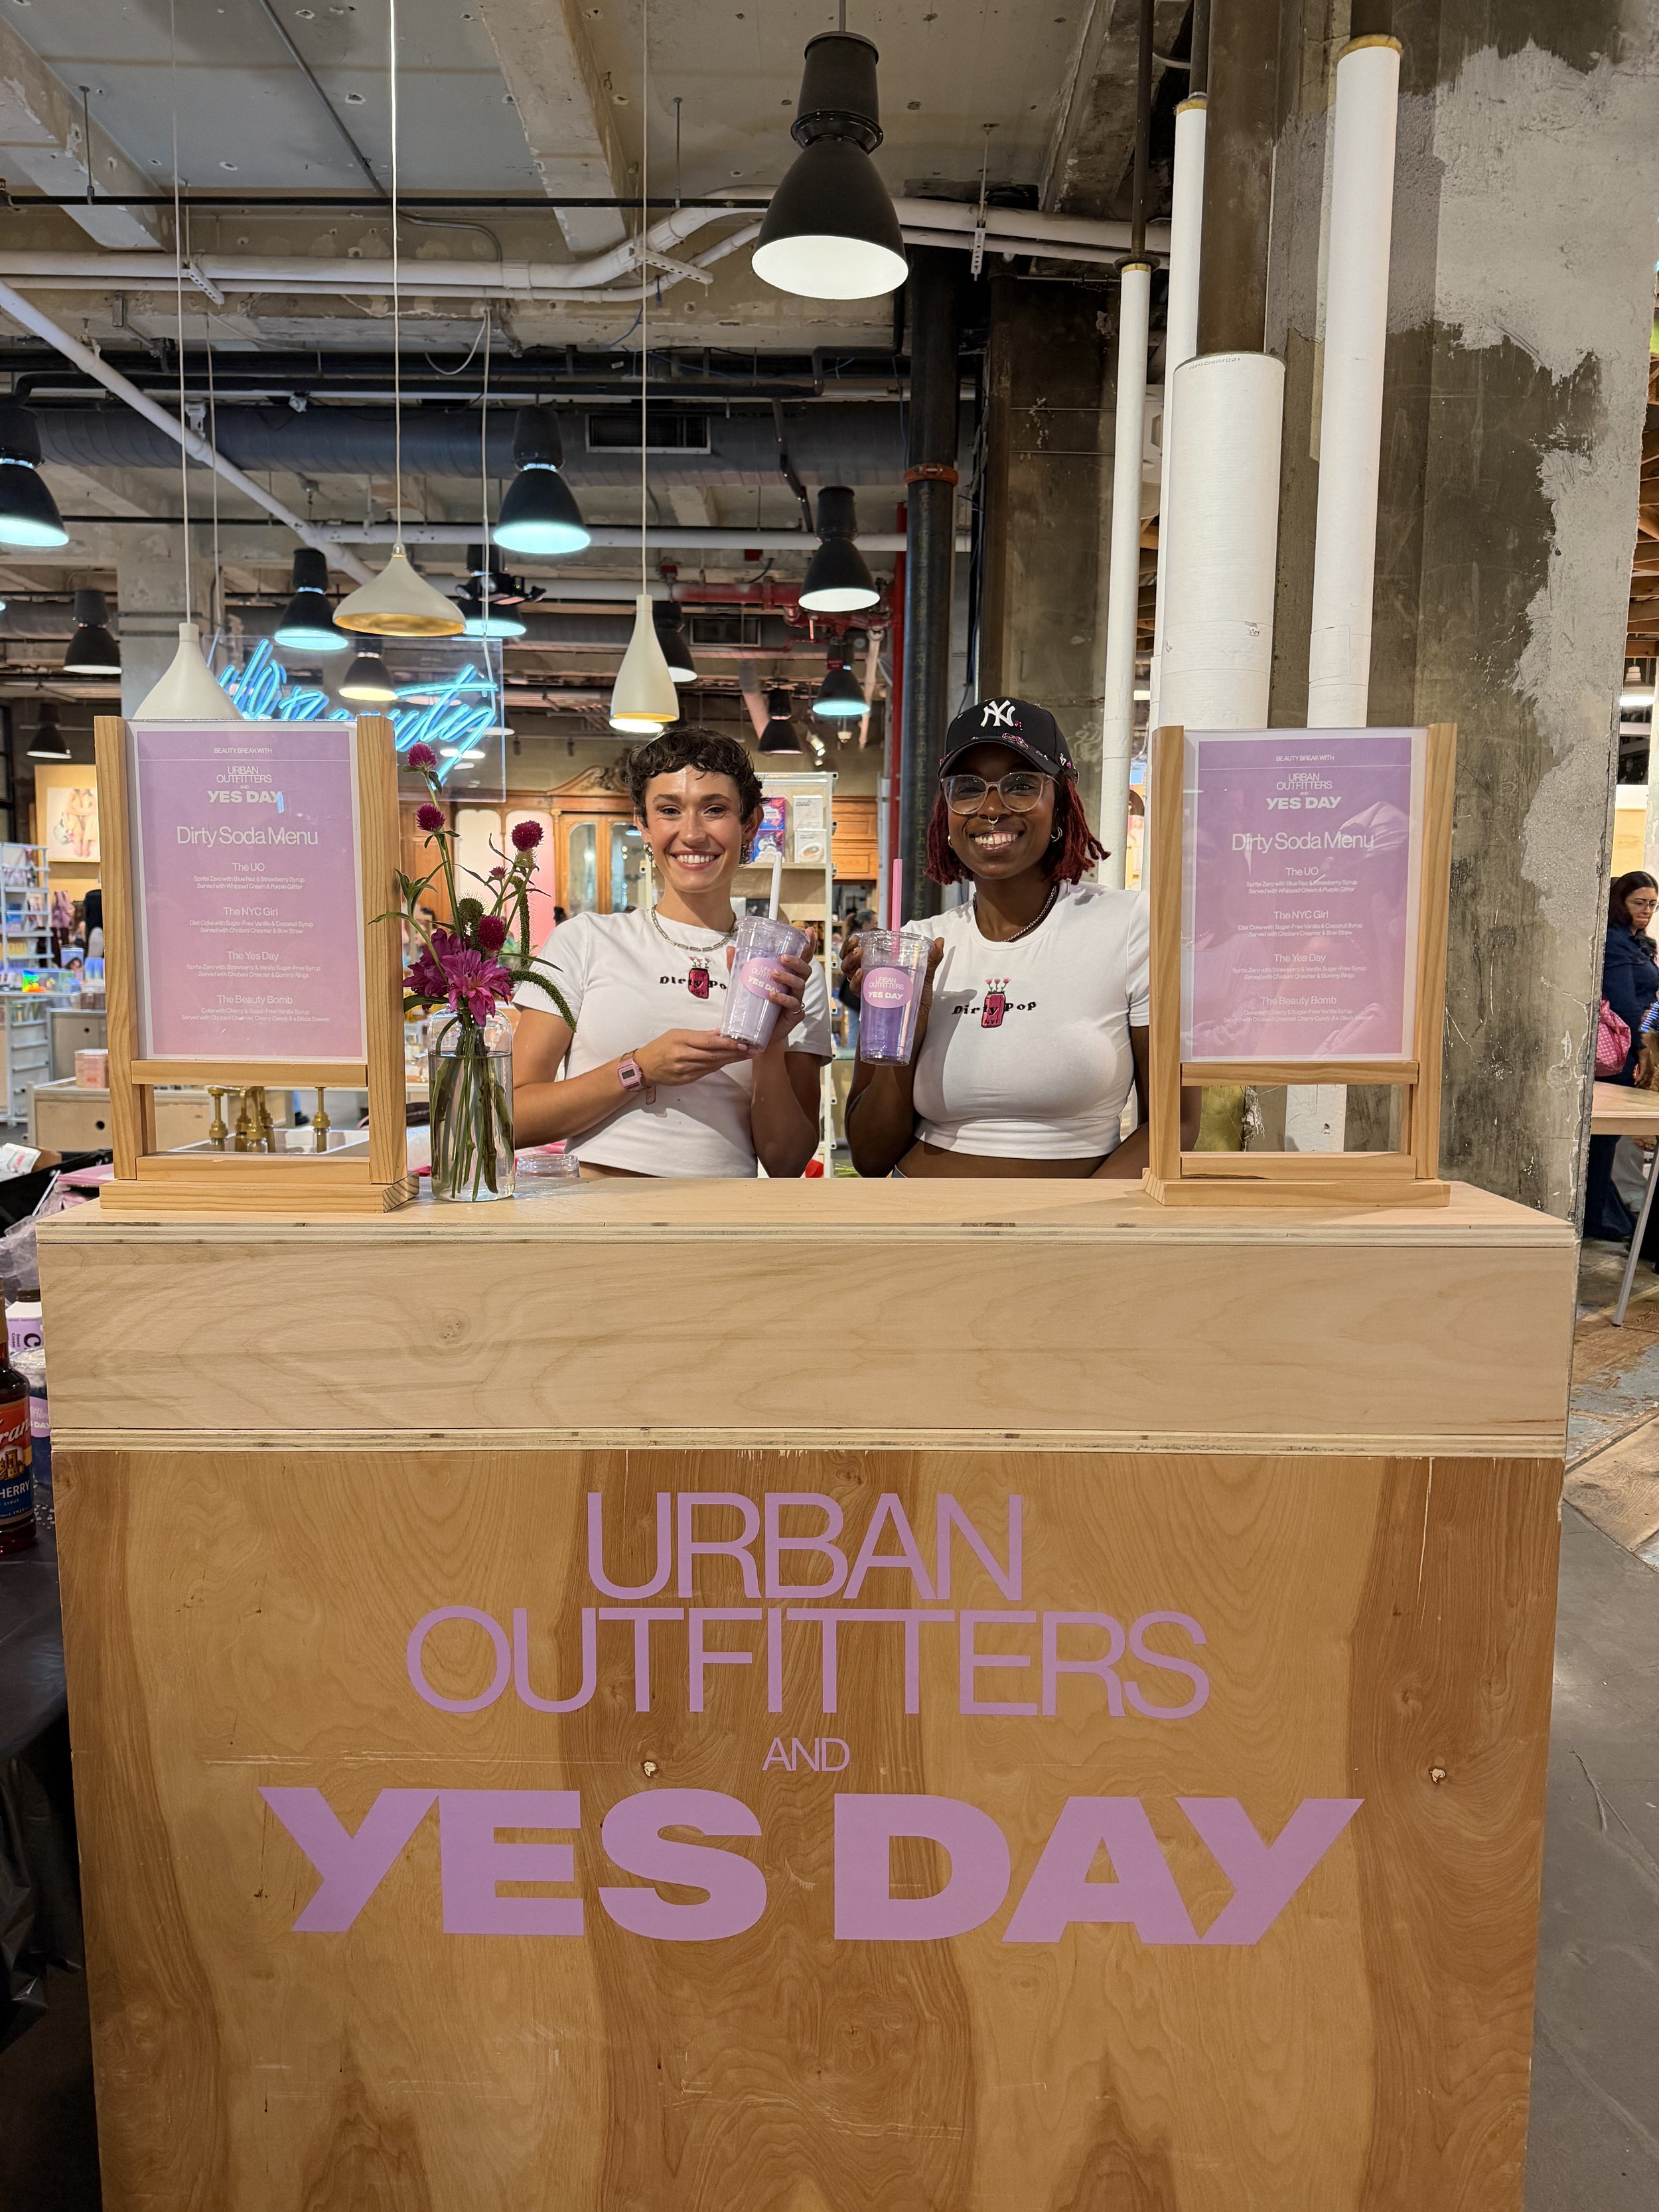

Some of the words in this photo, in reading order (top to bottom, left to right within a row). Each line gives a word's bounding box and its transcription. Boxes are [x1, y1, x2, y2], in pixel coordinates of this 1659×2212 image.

[980, 700, 1015, 727] NY
[217, 774, 272, 783] OUTFITTERS
[1288, 773, 1319, 782] URBAN
[1276, 781, 1333, 790] OUTFITTERS
[207, 790, 242, 803] YES
[1265, 797, 1302, 810] YES
[1305, 796, 1342, 809] DAY
[177, 826, 216, 848] Dirty
[219, 826, 265, 845] Soda
[268, 827, 319, 846] Menu
[1232, 833, 1273, 853] Dirty
[1275, 832, 1321, 849] Soda
[1325, 831, 1374, 849] Menu
[232, 863, 249, 871] The
[251, 863, 265, 871] UO
[1285, 867, 1303, 876] The
[1304, 867, 1319, 875] UO
[223, 907, 240, 916] The
[242, 907, 261, 916] NYC
[263, 907, 278, 917] Girl
[1292, 911, 1312, 919] NYC
[1313, 910, 1329, 919] Girl
[226, 951, 244, 960] The
[245, 951, 261, 960] Yes
[262, 952, 279, 962] Day
[1292, 954, 1307, 962] Yes
[1309, 954, 1326, 963] Day
[709, 980, 727, 990] Po
[748, 976, 764, 988] YES
[216, 994, 234, 1003] The
[236, 995, 265, 1005] Beauty
[267, 995, 293, 1004] Bomb
[1261, 997, 1277, 1005] The
[1279, 996, 1309, 1006] Beauty
[1311, 995, 1337, 1004] Bomb
[1004, 1001, 1037, 1011] Pop
[588, 1493, 1022, 1602] URBAN
[405, 1606, 1210, 1720] OUTFITTERS
[762, 1737, 851, 1773] AND
[257, 1787, 768, 1941] YES
[834, 1794, 1365, 1947] DAY
